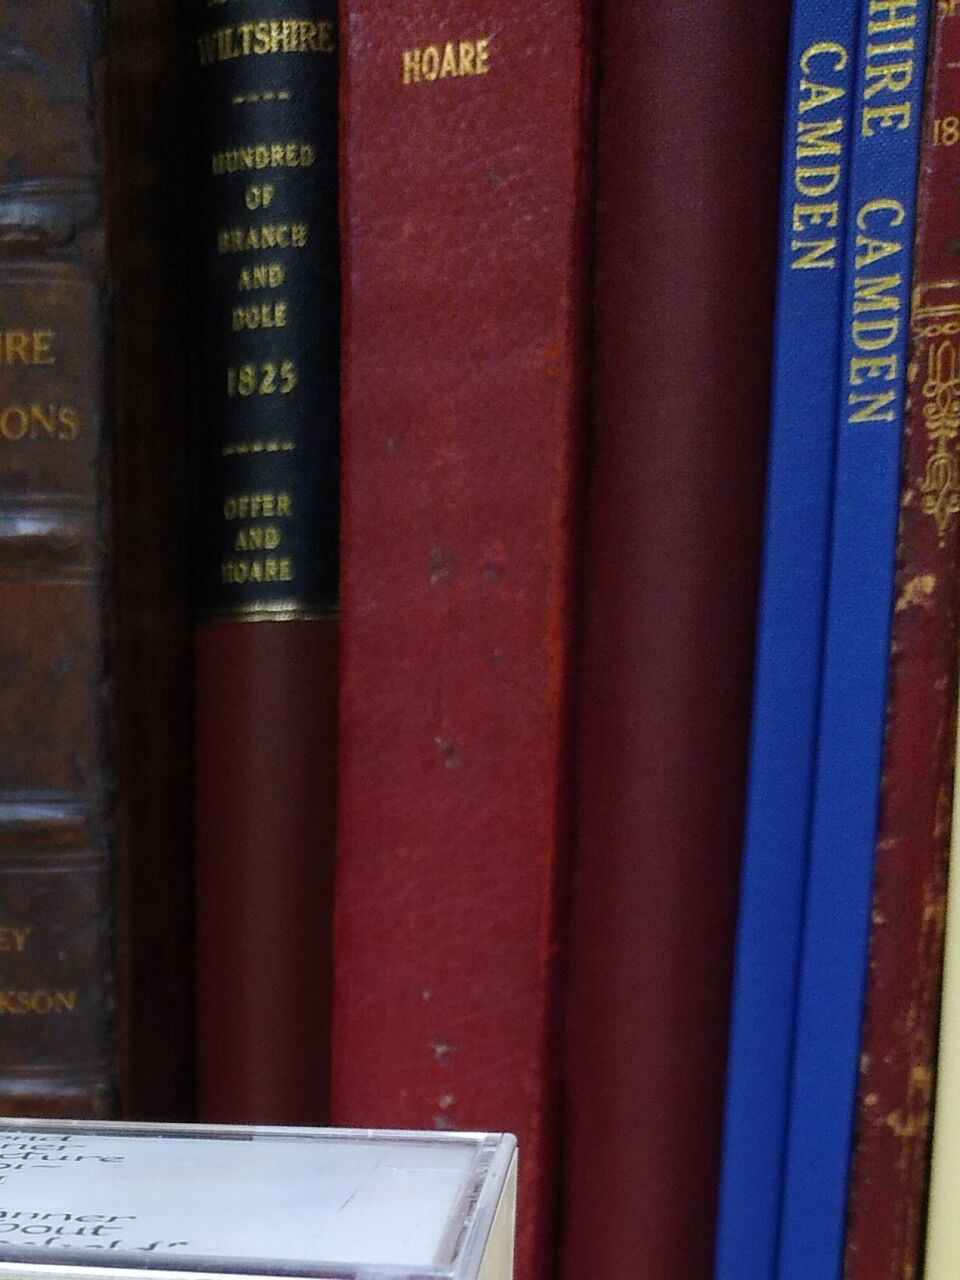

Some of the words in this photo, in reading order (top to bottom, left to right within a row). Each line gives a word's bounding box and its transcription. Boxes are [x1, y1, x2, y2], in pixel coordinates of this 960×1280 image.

[198, 20, 335, 65] WILTSHIRE
[402, 39, 491, 84] HOARE
[212, 143, 316, 175] HUNDRED
[791, 41, 849, 273] CAMDEN
[246, 184, 275, 210] OF
[218, 223, 309, 253] BRANCH
[240, 263, 284, 289] AND
[848, 198, 907, 425] CAMDEN
[227, 362, 297, 397] 1825
[224, 493, 292, 520] OFFER
[235, 526, 281, 551] AND
[222, 558, 294, 583] HOARE
